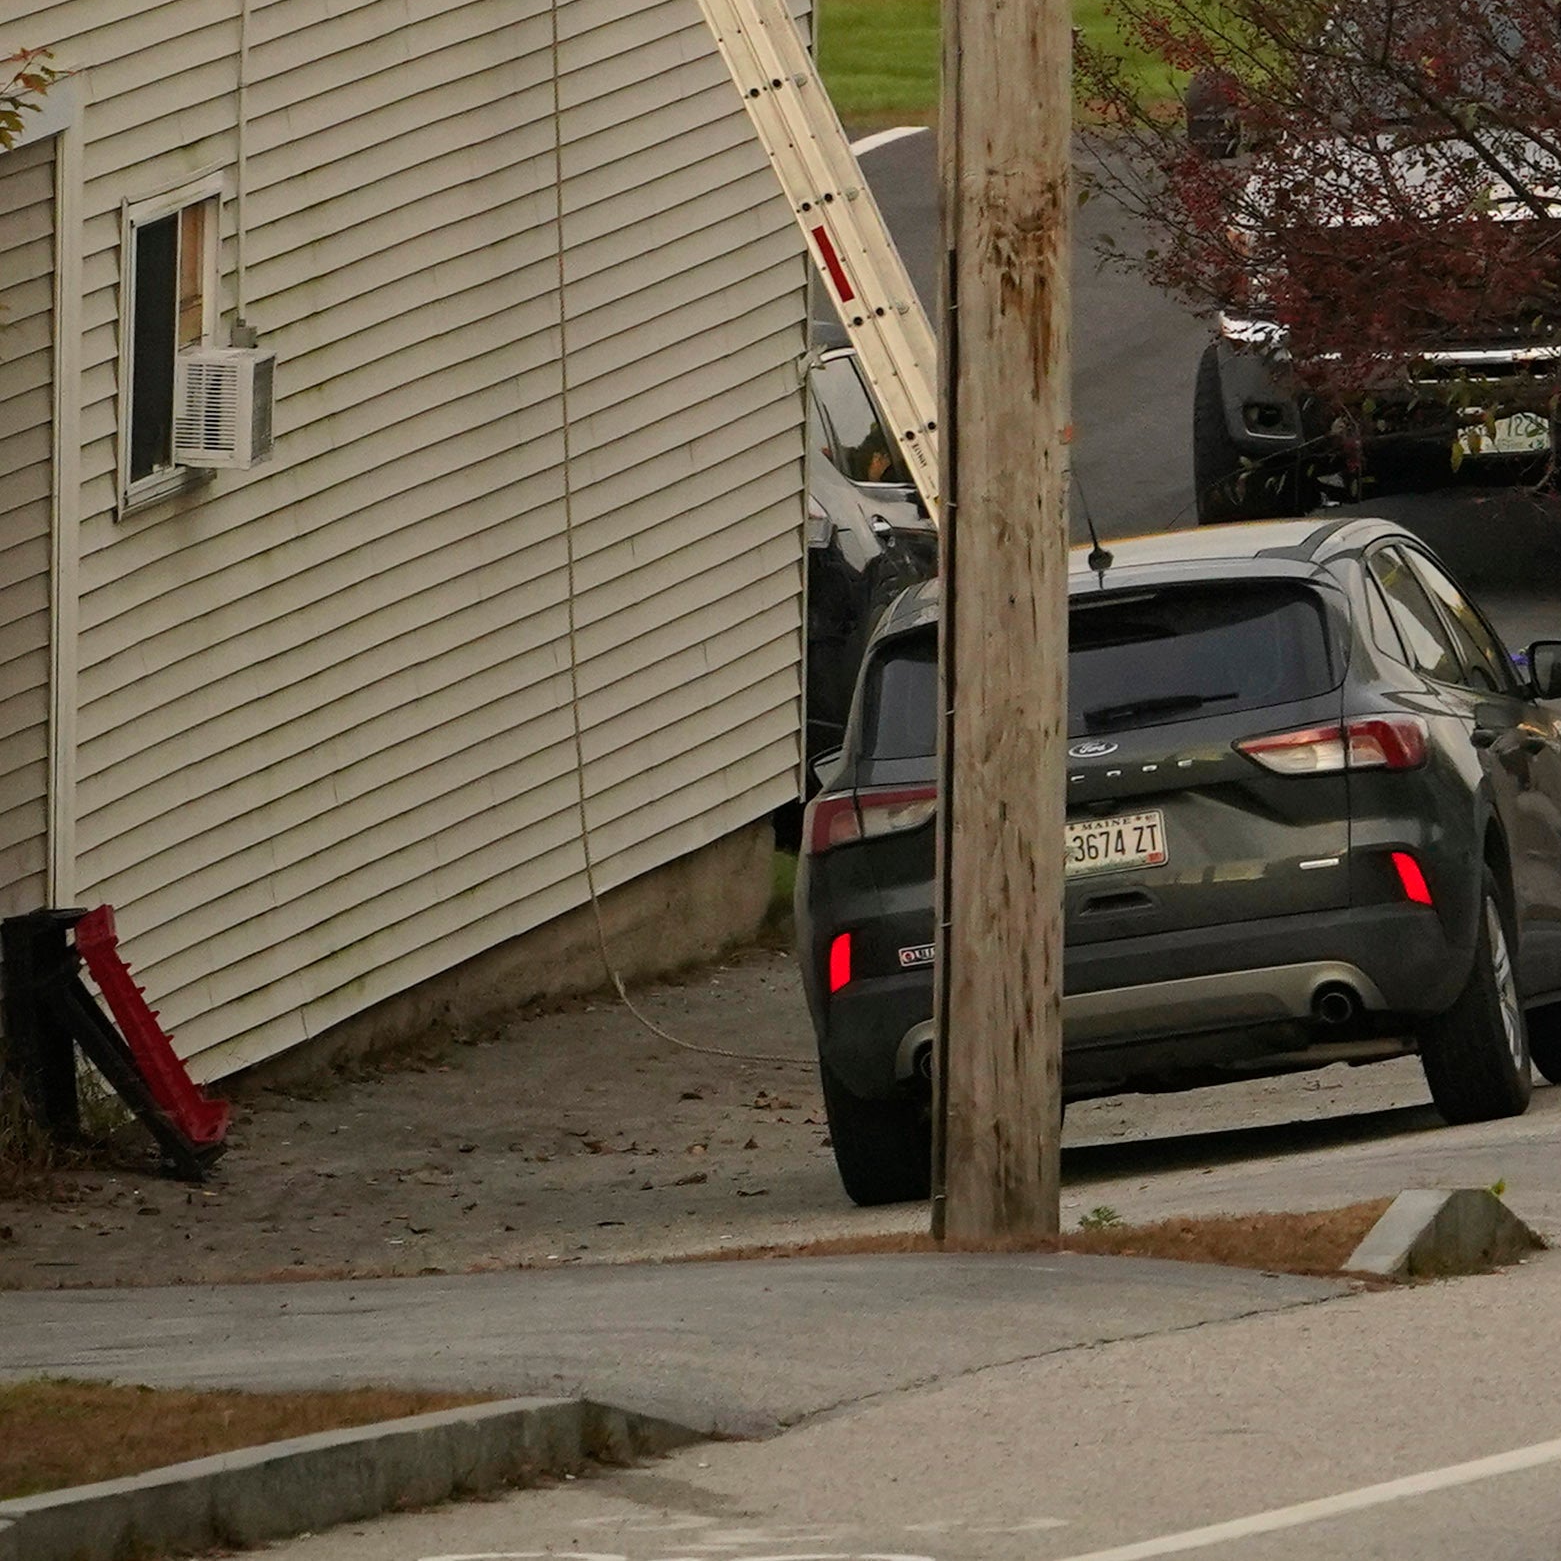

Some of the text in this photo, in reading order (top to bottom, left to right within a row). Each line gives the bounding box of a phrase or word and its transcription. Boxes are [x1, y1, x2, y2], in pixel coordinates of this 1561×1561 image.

[1082, 818, 1131, 831] MAINE
[1073, 824, 1157, 862] 3674 ZT
